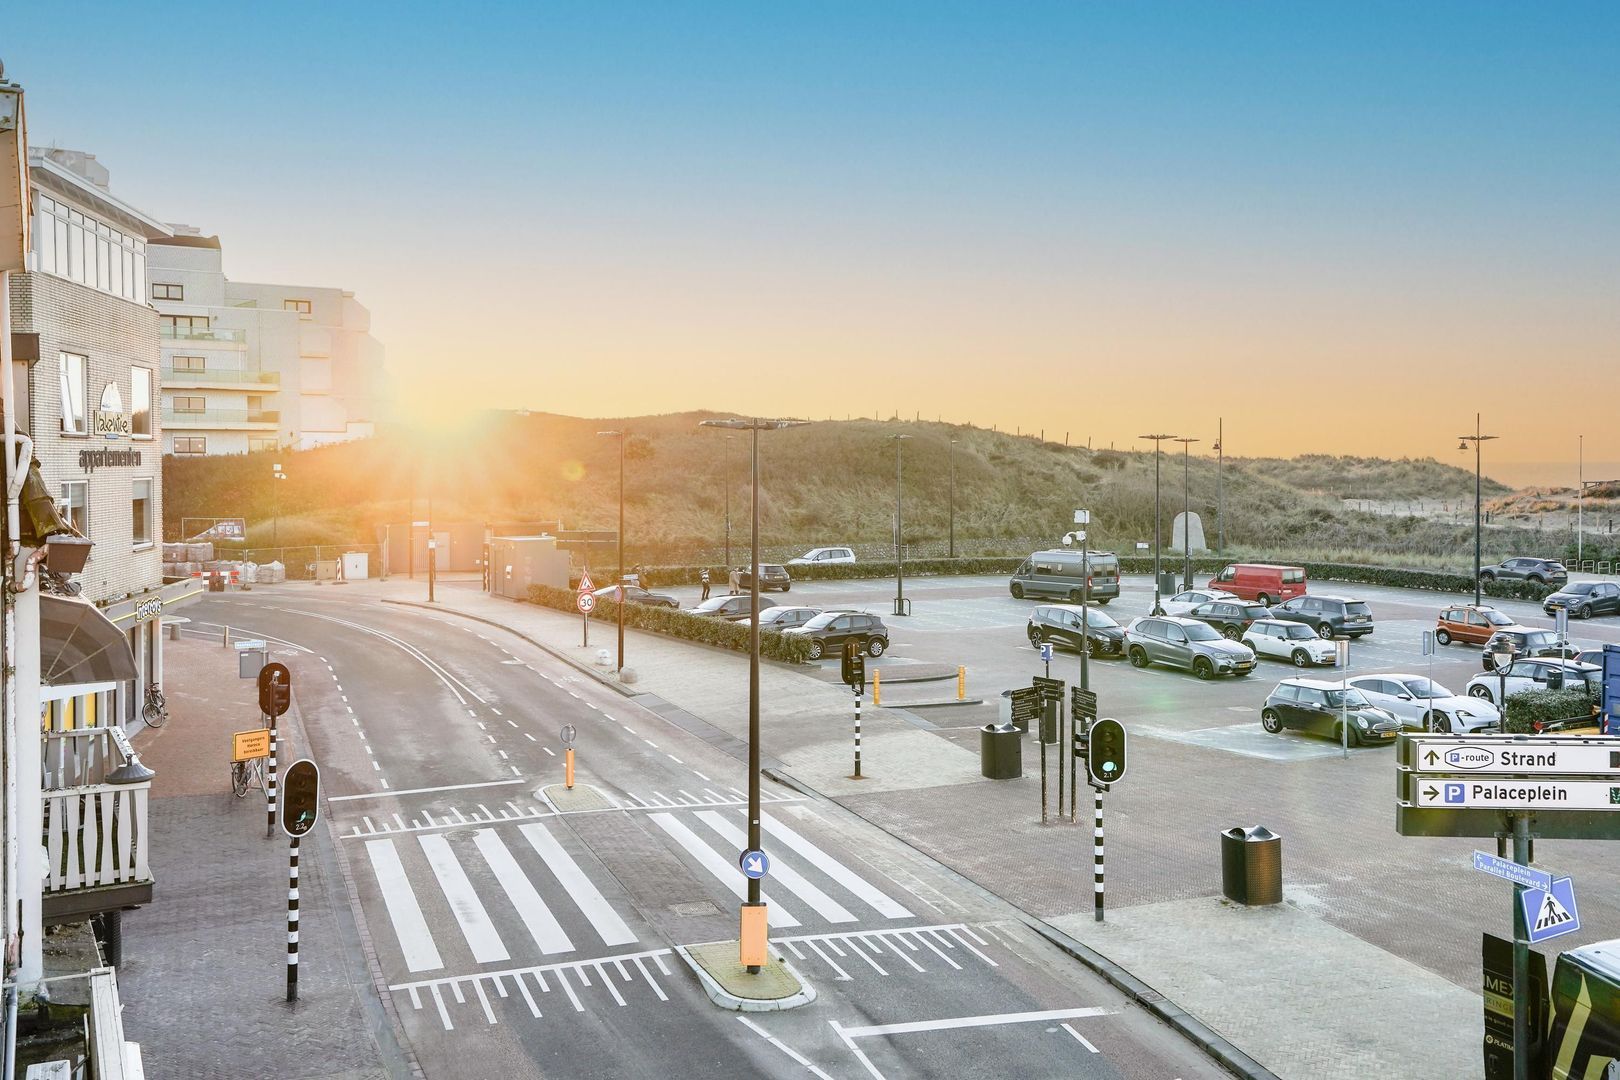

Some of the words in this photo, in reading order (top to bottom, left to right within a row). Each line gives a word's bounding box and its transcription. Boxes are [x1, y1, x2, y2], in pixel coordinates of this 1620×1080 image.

[79, 446, 141, 474] appartementen
[581, 598, 592, 607] 30
[1501, 751, 1556, 766] Strand
[1472, 785, 1567, 802] Palaceplein
[1492, 858, 1531, 877] Palaceplein
[1506, 870, 1541, 887] Boulevard
